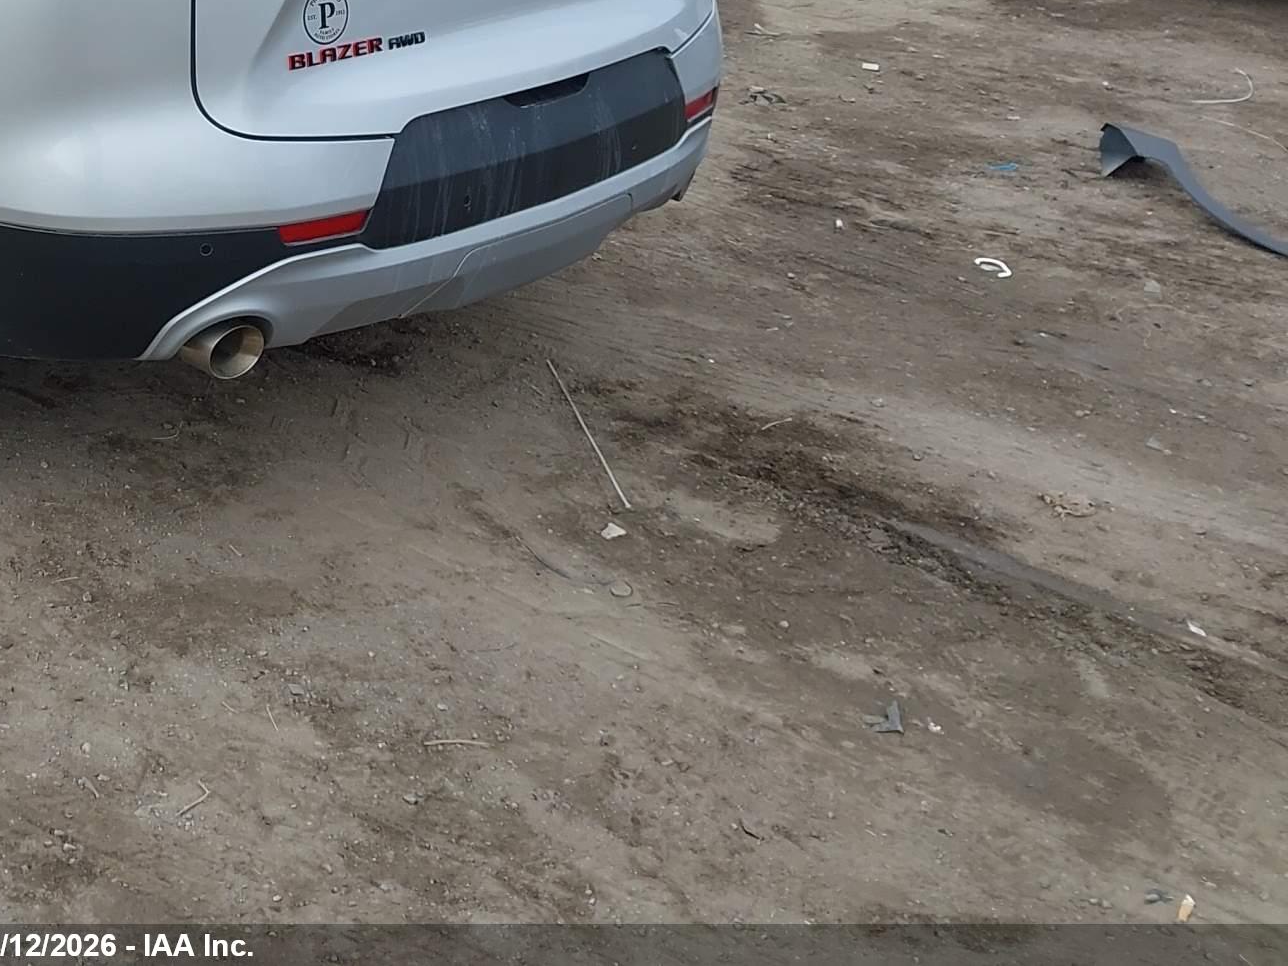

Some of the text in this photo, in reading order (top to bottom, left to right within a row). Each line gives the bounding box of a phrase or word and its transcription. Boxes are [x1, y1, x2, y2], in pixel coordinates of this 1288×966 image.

[318, 2, 336, 30] P
[287, 31, 426, 71] BLAZER AWD
